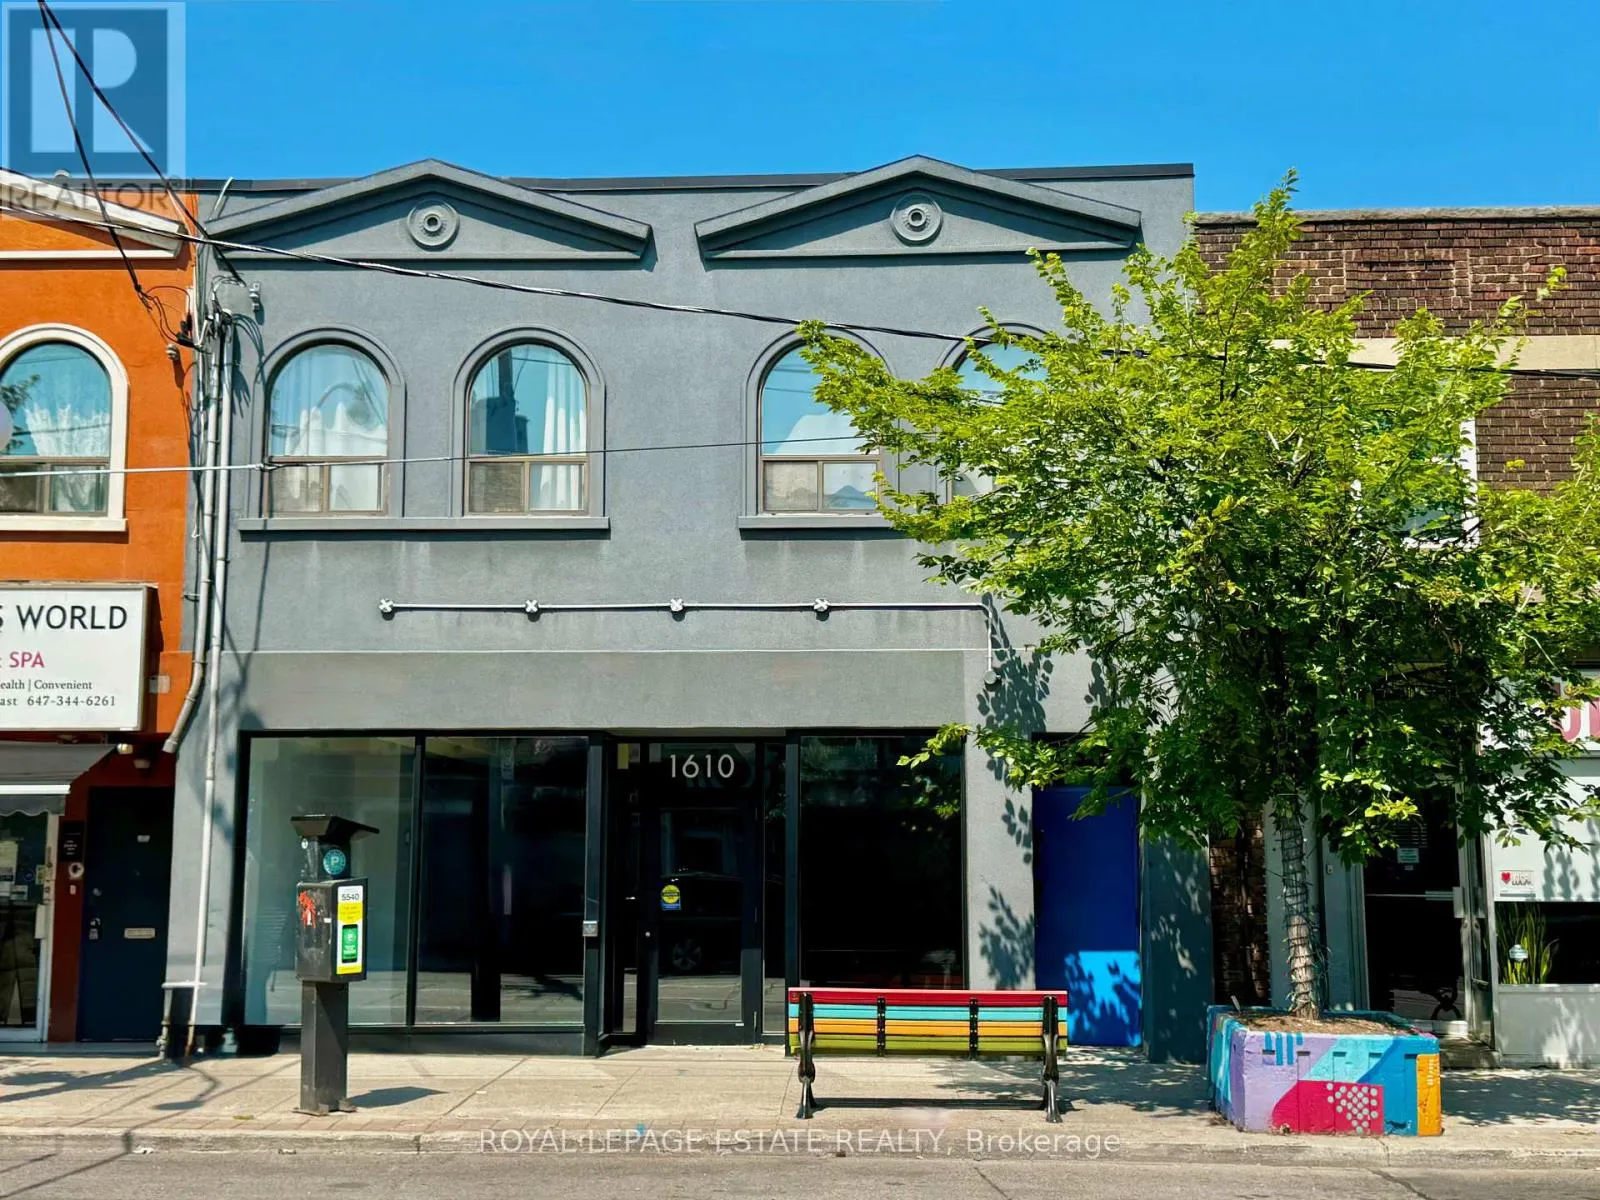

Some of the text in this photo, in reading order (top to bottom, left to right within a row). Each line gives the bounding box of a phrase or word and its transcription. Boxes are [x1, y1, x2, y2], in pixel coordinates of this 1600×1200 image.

[16, 604, 128, 631] WORLD
[9, 651, 46, 669] SPA
[33, 679, 93, 691] Convenient
[27, 695, 116, 707] 647-344-6261
[670, 753, 735, 779] 1610
